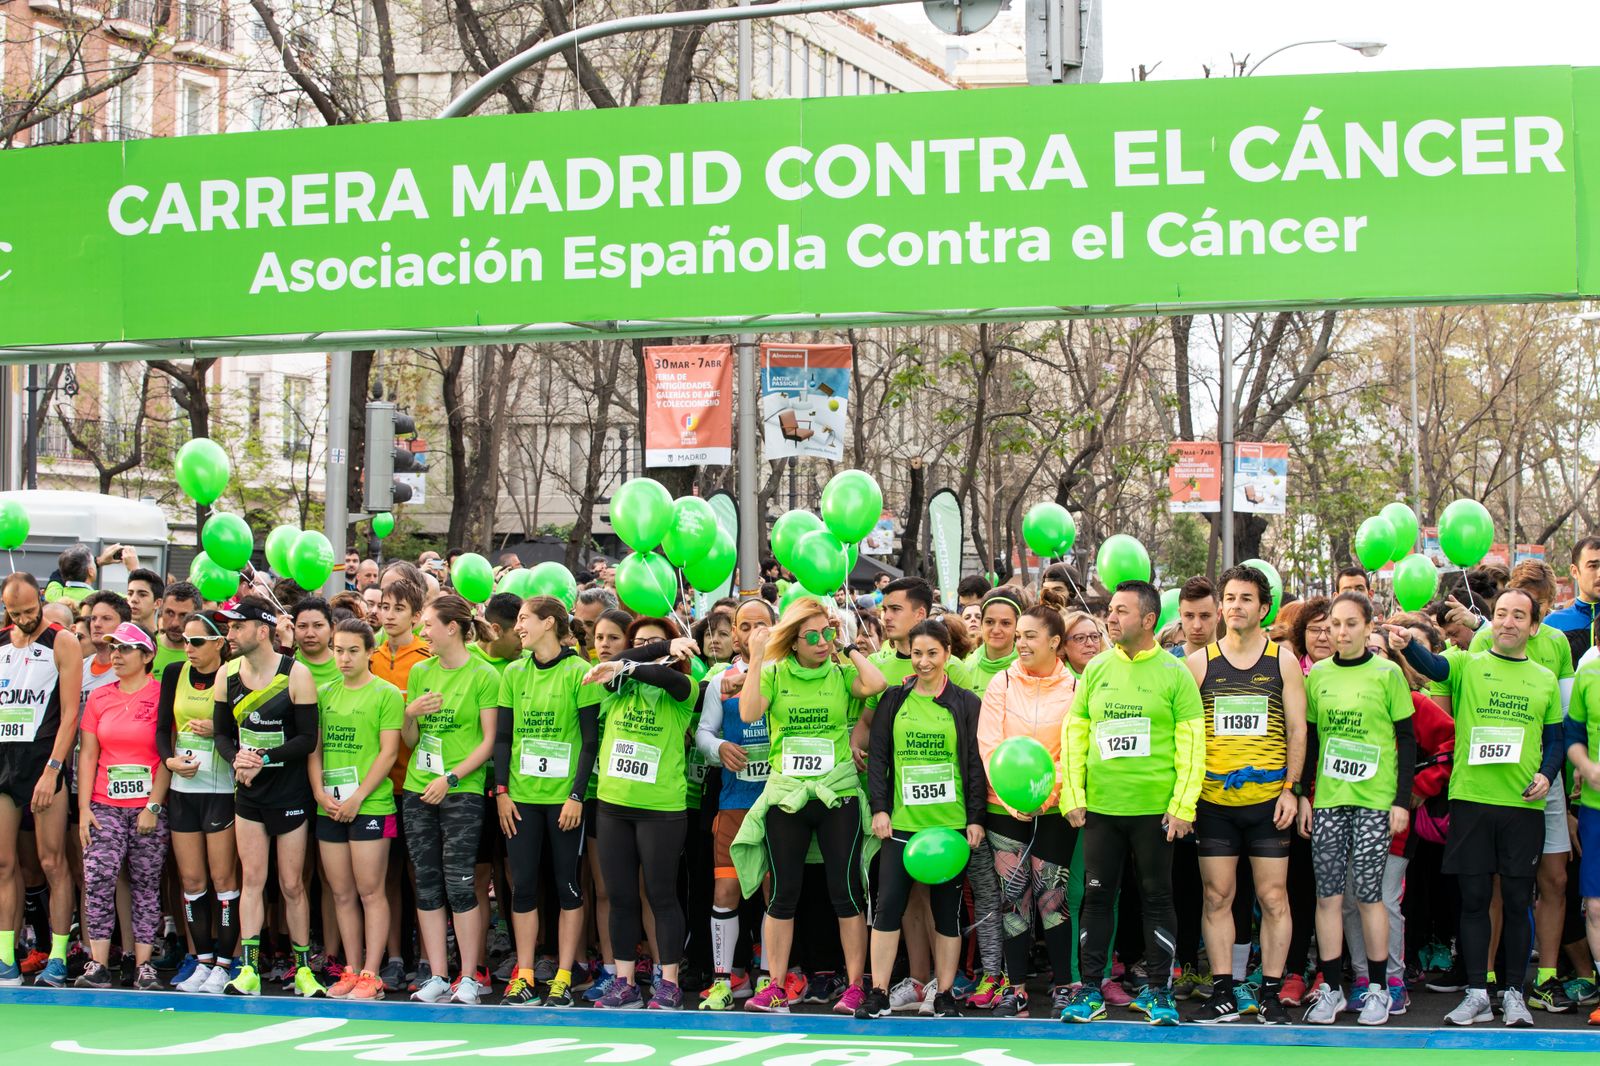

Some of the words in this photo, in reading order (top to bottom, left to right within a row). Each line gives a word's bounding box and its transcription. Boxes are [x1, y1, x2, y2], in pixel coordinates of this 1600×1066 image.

[108, 167, 430, 236] CARRERA
[452, 150, 742, 217] MADRID
[765, 133, 1089, 201] CONTRA
[1114, 129, 1205, 187] EL
[1229, 106, 1566, 183] CÁNCER
[249, 237, 543, 294] Asociación
[564, 224, 826, 289] Española
[846, 221, 1051, 268] Contra
[1071, 211, 1124, 260] el
[1146, 207, 1368, 258] Cáncer
[704, 389, 721, 398] ARTE
[677, 453, 708, 461] MADRID
[1490, 690, 1499, 698] VI
[1499, 691, 1530, 702] Carrera
[1114, 702, 1143, 711] Carrera
[1489, 697, 1529, 712] Madrid
[523, 716, 555, 727] Madrid
[623, 711, 656, 725] Madrid
[788, 714, 829, 724] Madrid
[1103, 710, 1143, 719] Madrid
[1475, 706, 1501, 715] contra
[1511, 710, 1535, 722] cáncer
[640, 723, 664, 732] cáncer
[1222, 714, 1260, 730] 11387
[1, 723, 25, 737] 7981
[915, 731, 946, 739] Carrera
[906, 739, 945, 749] Madrid
[1106, 735, 1138, 752] 1257
[184, 749, 194, 764] 2
[920, 748, 927, 756] el
[928, 749, 953, 758] cáncer
[1479, 744, 1512, 759] 8557
[426, 752, 432, 768] 5
[538, 757, 548, 773] 3
[616, 758, 649, 776] 9360
[792, 755, 823, 771] 7732
[1332, 758, 1367, 778] 4302
[112, 780, 145, 794] 8558
[333, 785, 340, 801] 4
[912, 783, 947, 799] 5354
